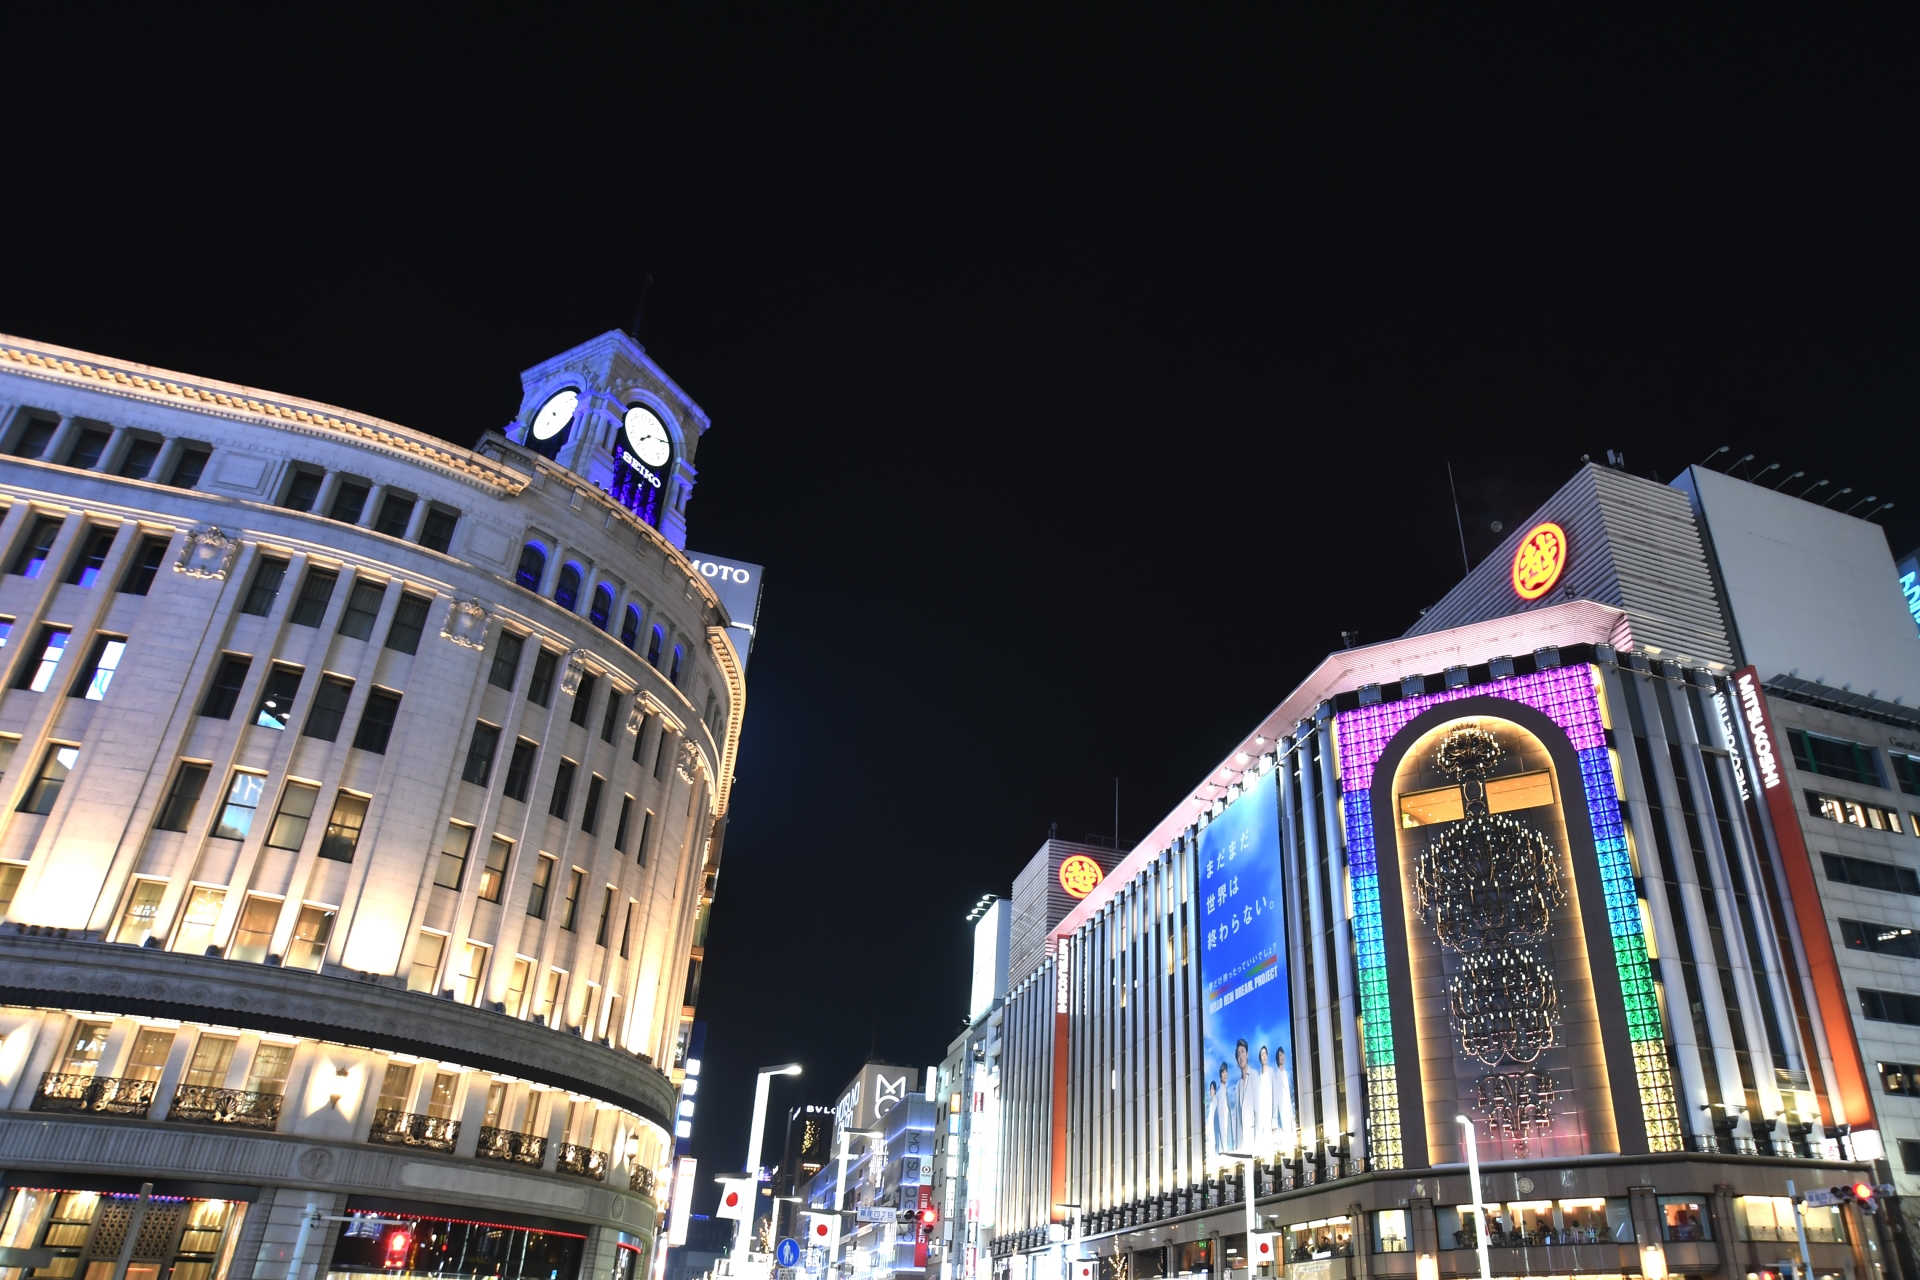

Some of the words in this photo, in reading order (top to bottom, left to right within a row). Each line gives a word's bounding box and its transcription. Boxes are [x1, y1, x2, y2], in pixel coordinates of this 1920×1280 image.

[623, 451, 661, 488] SEIKO
[1738, 674, 1780, 789] MITSUKOSHI
[1206, 828, 1249, 879] まだまだ
[1206, 876, 1239, 915] 世界は
[1207, 896, 1275, 951] 終わらない。
[1209, 997, 1223, 1015] HELLO
[1224, 990, 1235, 1007] NEW
[1254, 965, 1278, 989] PROJECT
